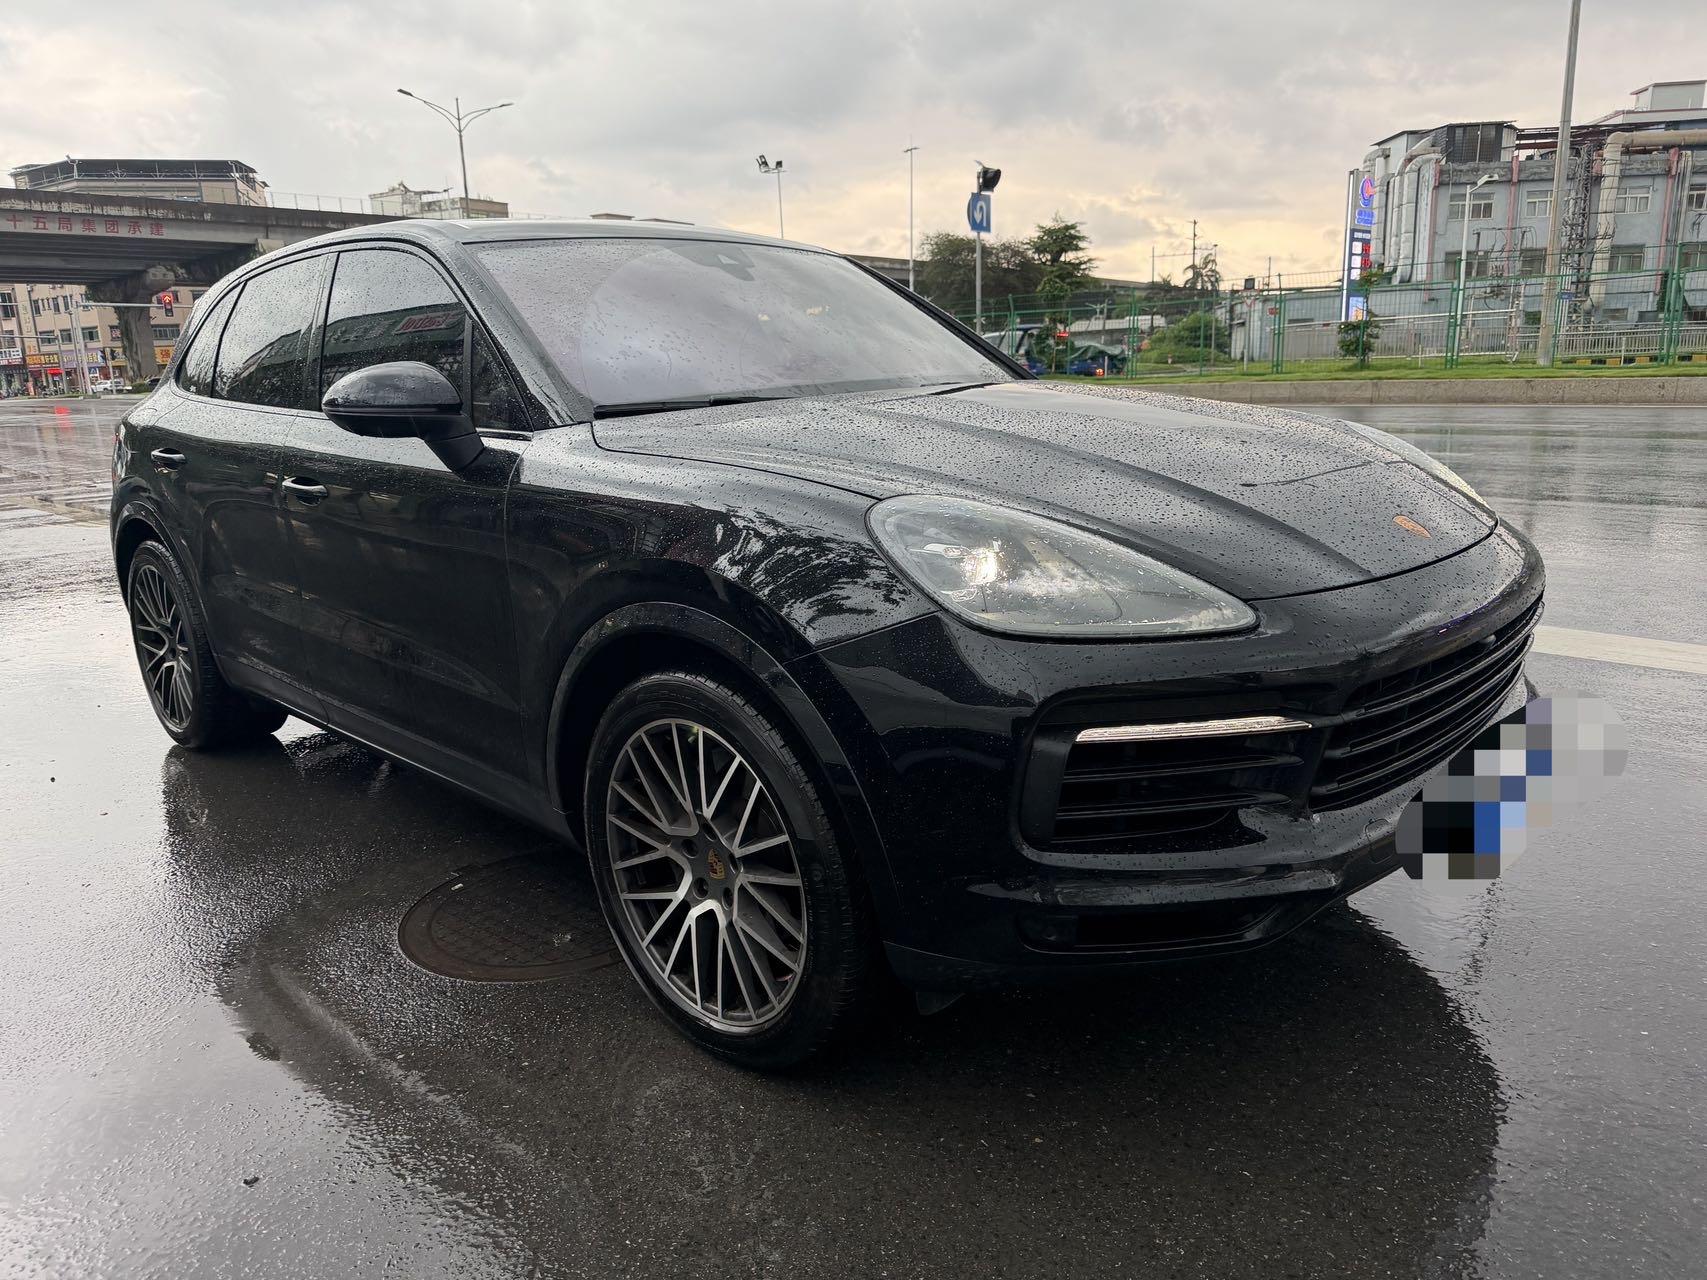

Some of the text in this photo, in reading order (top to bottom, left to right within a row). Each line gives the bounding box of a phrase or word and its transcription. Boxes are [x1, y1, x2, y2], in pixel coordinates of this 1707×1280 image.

[5, 214, 164, 236] 十五局集团承建
